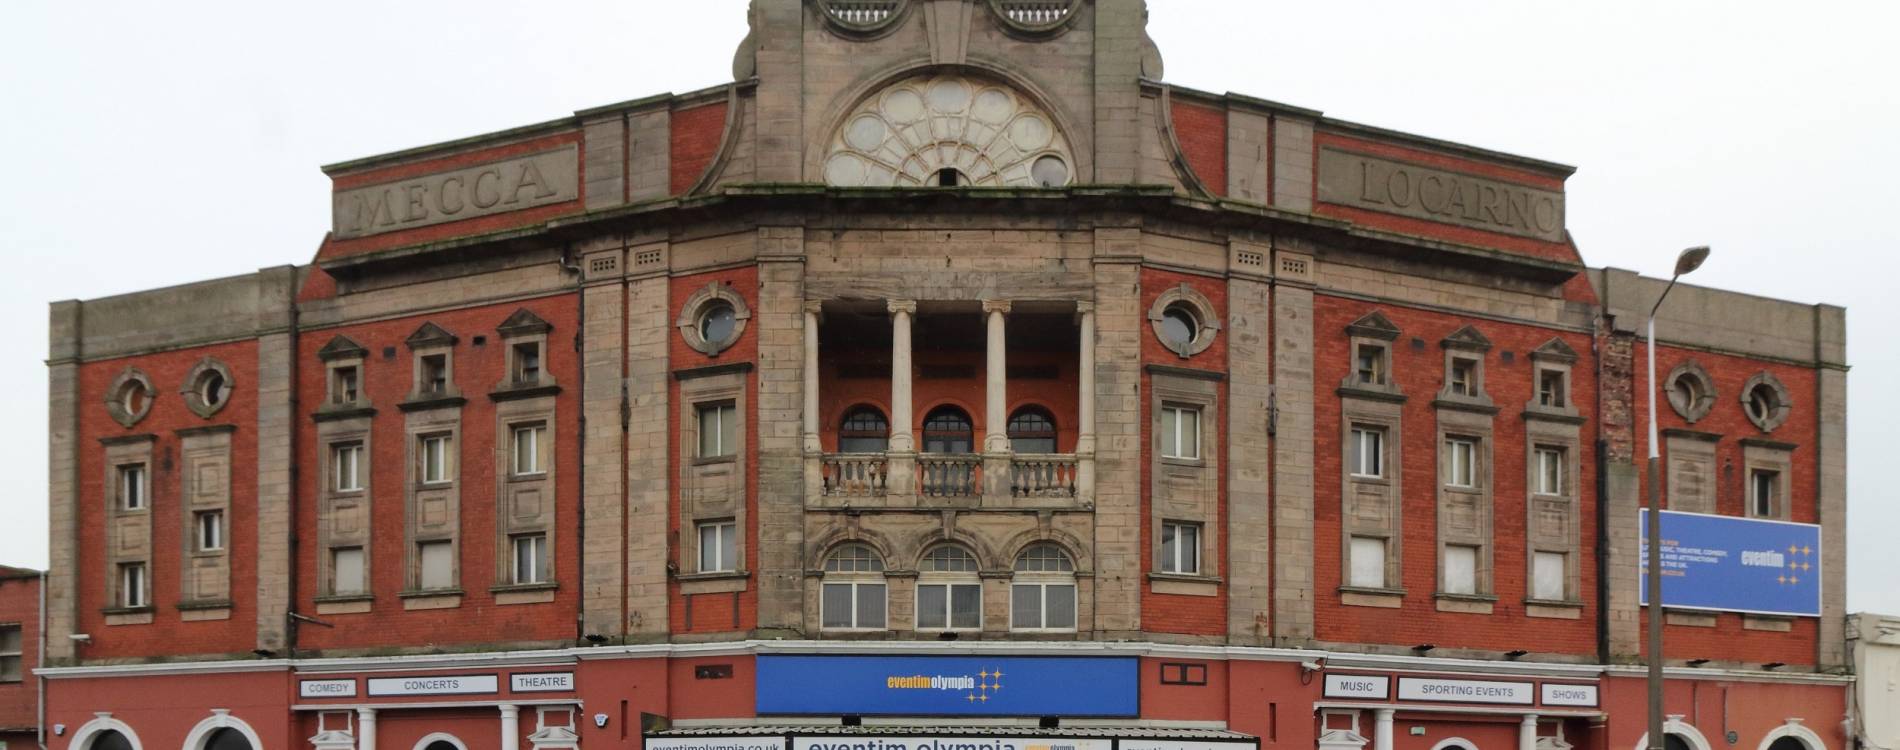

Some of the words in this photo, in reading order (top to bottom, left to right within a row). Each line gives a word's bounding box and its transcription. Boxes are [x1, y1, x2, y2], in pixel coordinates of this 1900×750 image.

[350, 159, 557, 232] MECCA
[1360, 161, 1557, 234] LOCARNO
[1741, 550, 1784, 568] eventim
[308, 682, 349, 693] COMEDY
[404, 679, 460, 690] CONCERTS
[518, 676, 568, 688] THEATRE
[887, 675, 975, 690] eventimolympia
[1340, 681, 1374, 692] MUSIC
[1422, 684, 1473, 696] SPORTING
[1476, 686, 1514, 697] EVENTS
[1552, 689, 1587, 700] SHOWS
